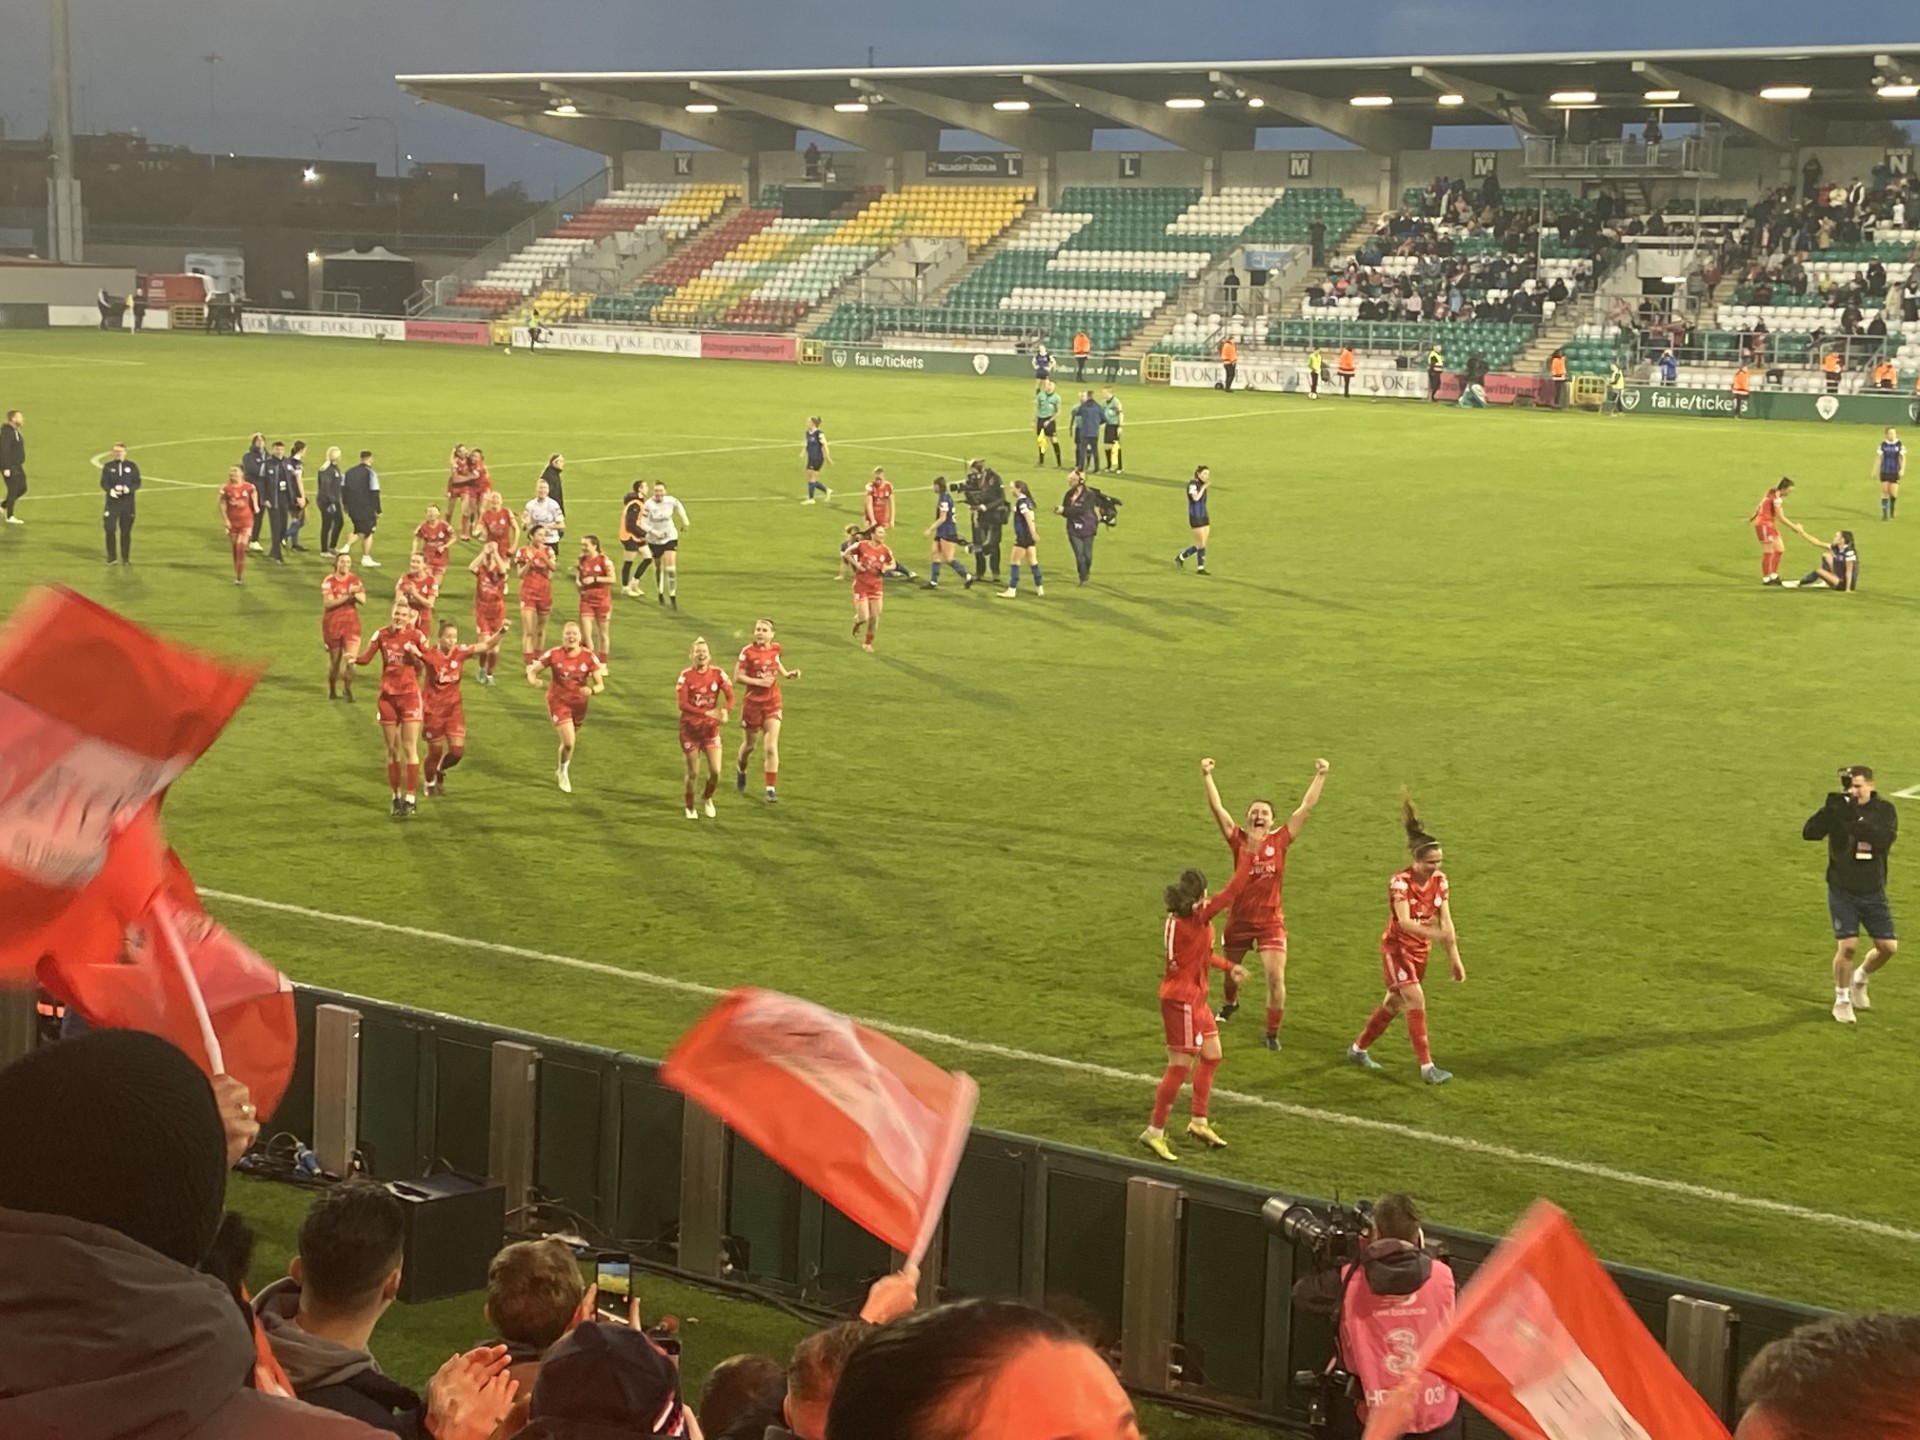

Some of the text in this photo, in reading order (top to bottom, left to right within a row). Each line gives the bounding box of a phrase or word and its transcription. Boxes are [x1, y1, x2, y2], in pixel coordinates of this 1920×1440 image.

[678, 158, 689, 173] K
[1008, 159, 1018, 175] L
[1125, 159, 1134, 175] L
[1291, 159, 1309, 176] M
[1474, 158, 1494, 175] M
[1890, 155, 1908, 174] N
[321, 321, 355, 334] EVOKE
[560, 332, 597, 347] EVOKE
[606, 335, 643, 349] EVOKE
[653, 337, 691, 352] EVOKE
[855, 352, 924, 369] fai.ie/tickets
[1174, 366, 1220, 382] EVOKE
[1235, 368, 1284, 386] EVOKE
[1363, 374, 1416, 390] EVOKE
[1384, 1328, 1419, 1376] 3
